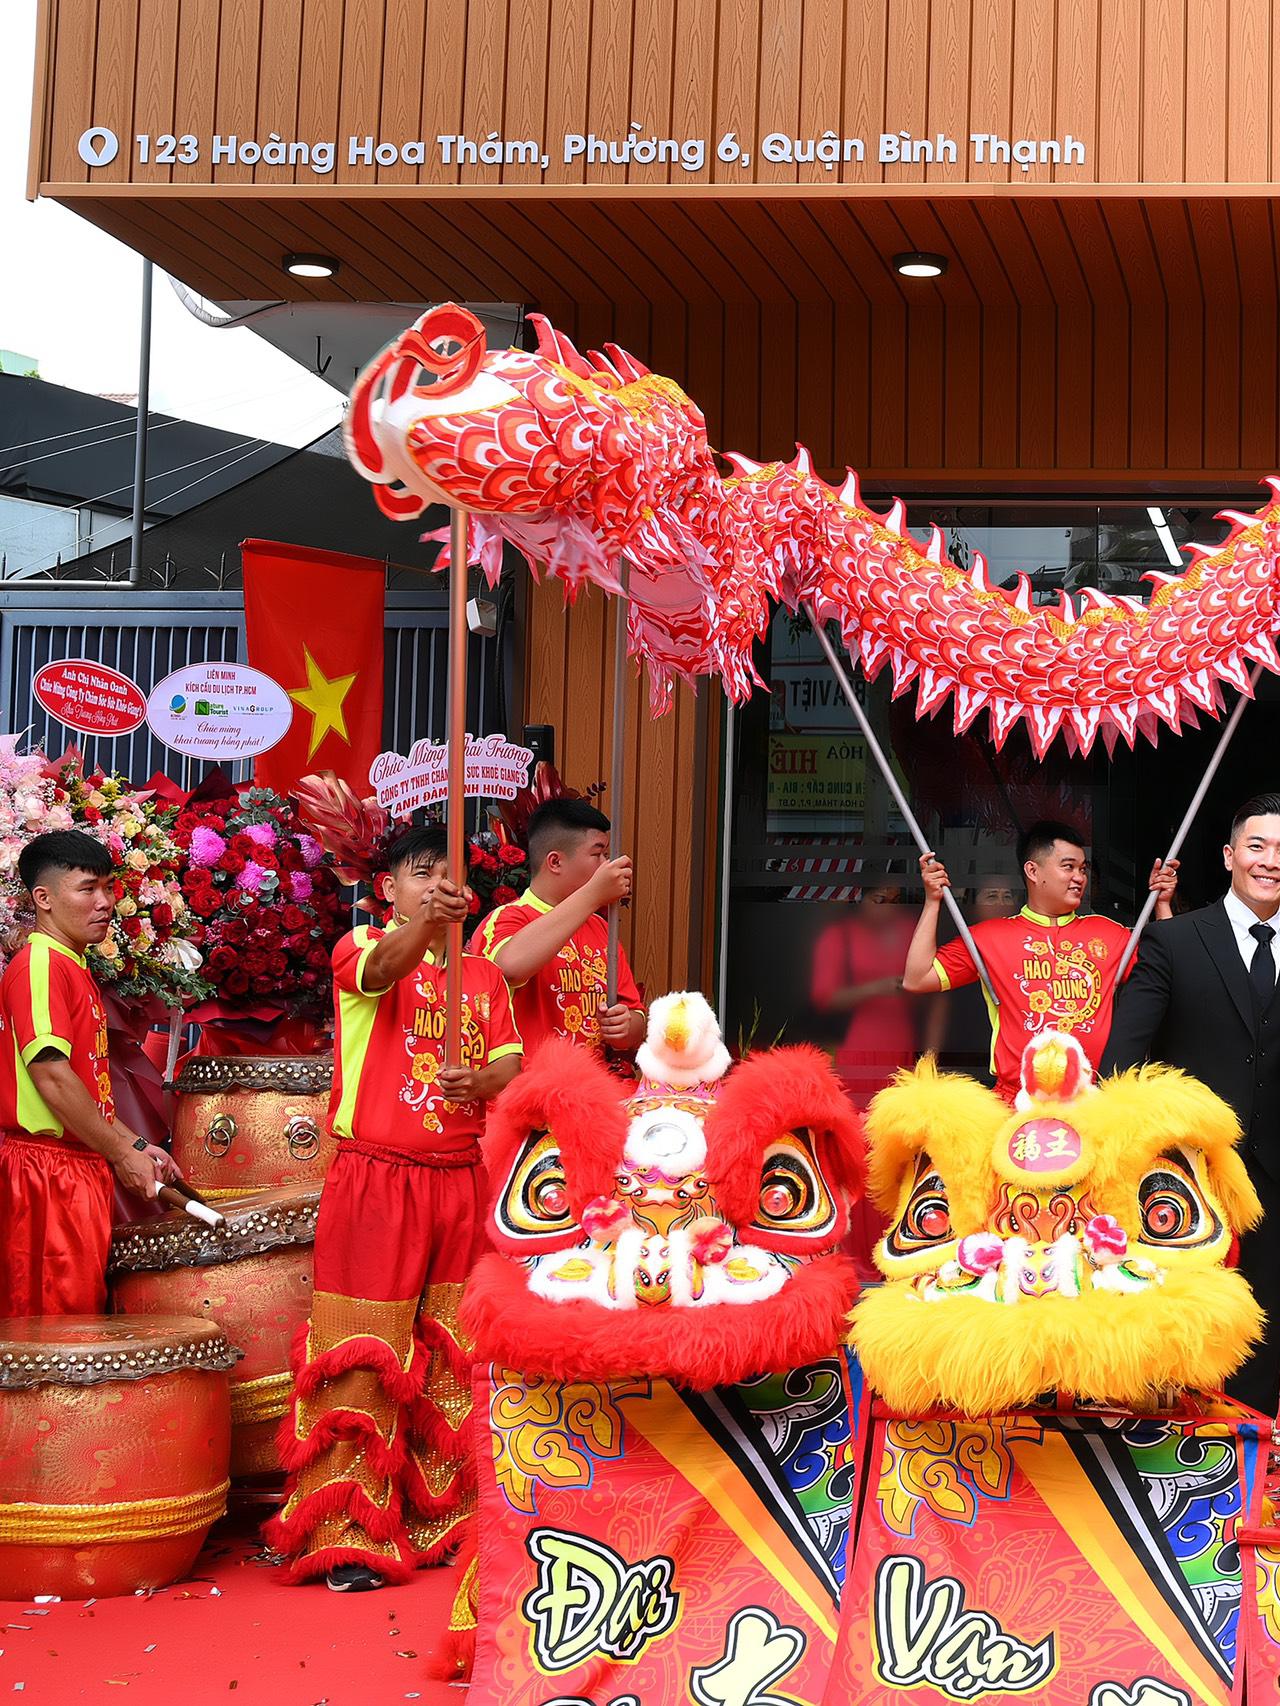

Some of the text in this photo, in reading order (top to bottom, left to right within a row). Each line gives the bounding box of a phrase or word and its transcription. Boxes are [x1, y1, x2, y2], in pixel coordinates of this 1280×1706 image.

[136, 121, 1085, 174] 123 Hoàng Hoa Thám, Phường 6, Quận Bình Thạnh
[62, 668, 76, 681] Anh
[78, 672, 90, 687] Chị
[110, 681, 128, 695] Oanh
[186, 681, 200, 692] KÍCH
[212, 684, 220, 693] DU
[222, 685, 234, 696] LỊCH
[236, 686, 256, 695] TP.HCM
[207, 669, 236, 680] LIÊN MINH
[374, 737, 531, 784] Chúc Mừng hai Trương
[380, 785, 399, 805] CÔNG
[400, 782, 410, 794] TY
[410, 772, 430, 791] TNHH
[500, 768, 526, 785] GIANG'S
[394, 796, 419, 814] ANH
[464, 784, 479, 794] NH
[483, 784, 514, 798] HƯNG
[558, 962, 581, 992] HÀO
[1023, 955, 1052, 980] HÀO
[1052, 974, 1088, 1000] DŨNG
[414, 1003, 445, 1039] HÀO
[527, 1531, 673, 1664] Đại
[879, 1557, 1051, 1694] Vạn
